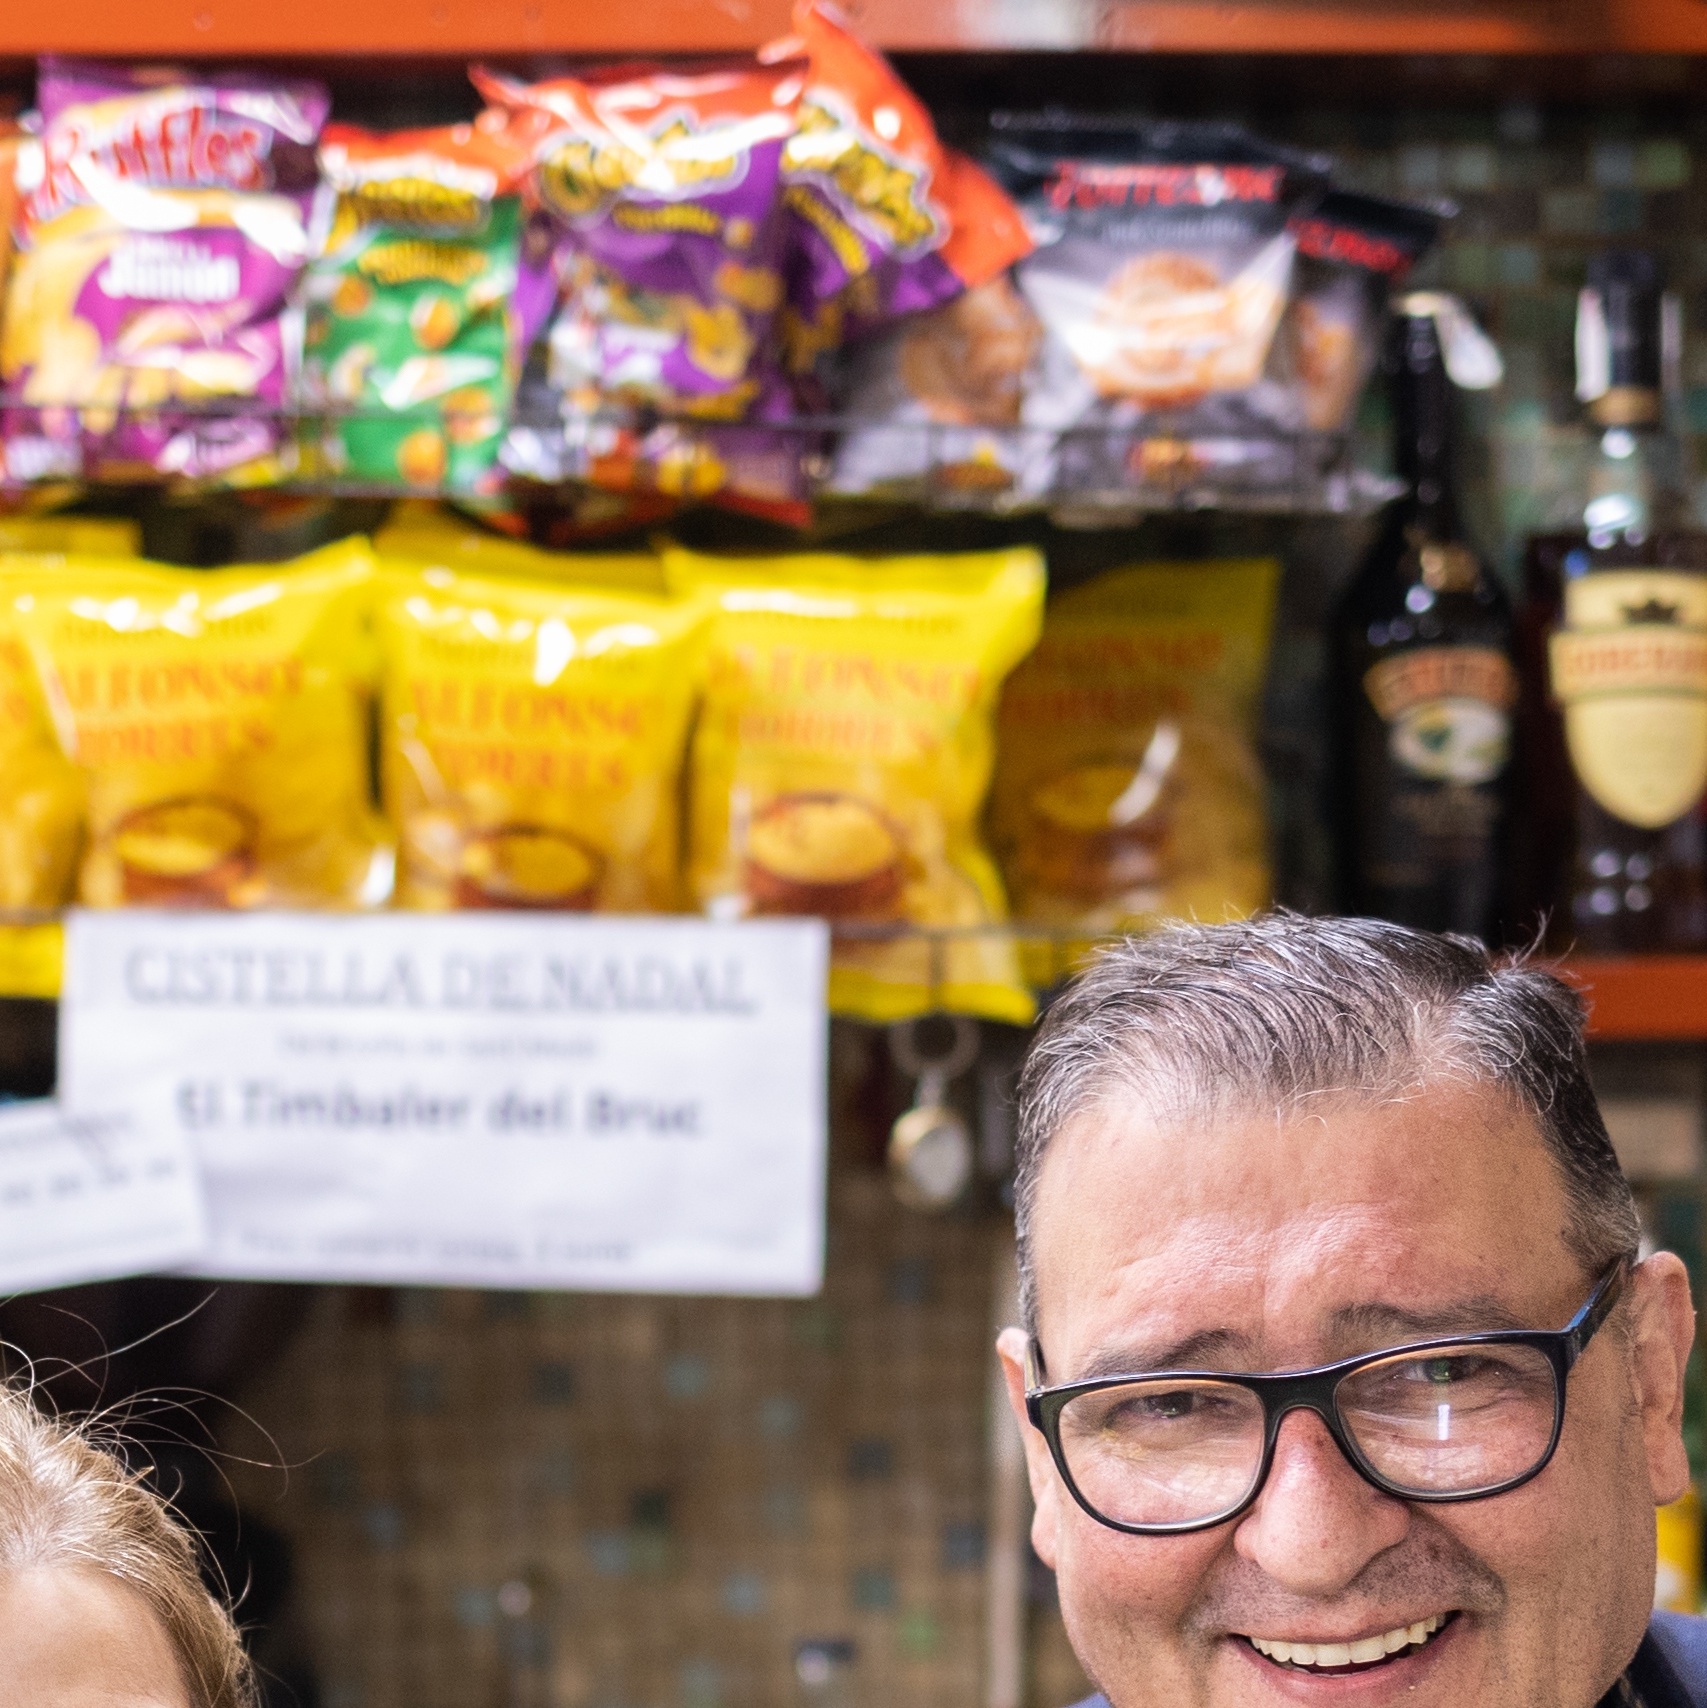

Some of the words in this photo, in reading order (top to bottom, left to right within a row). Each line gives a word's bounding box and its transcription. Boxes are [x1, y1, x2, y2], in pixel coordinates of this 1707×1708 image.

[30, 102, 270, 212] Ruffles
[124, 945, 424, 1008] CISTELLA
[441, 950, 532, 1010] DE
[539, 951, 757, 1014] NADAL
[486, 1083, 572, 1133] del
